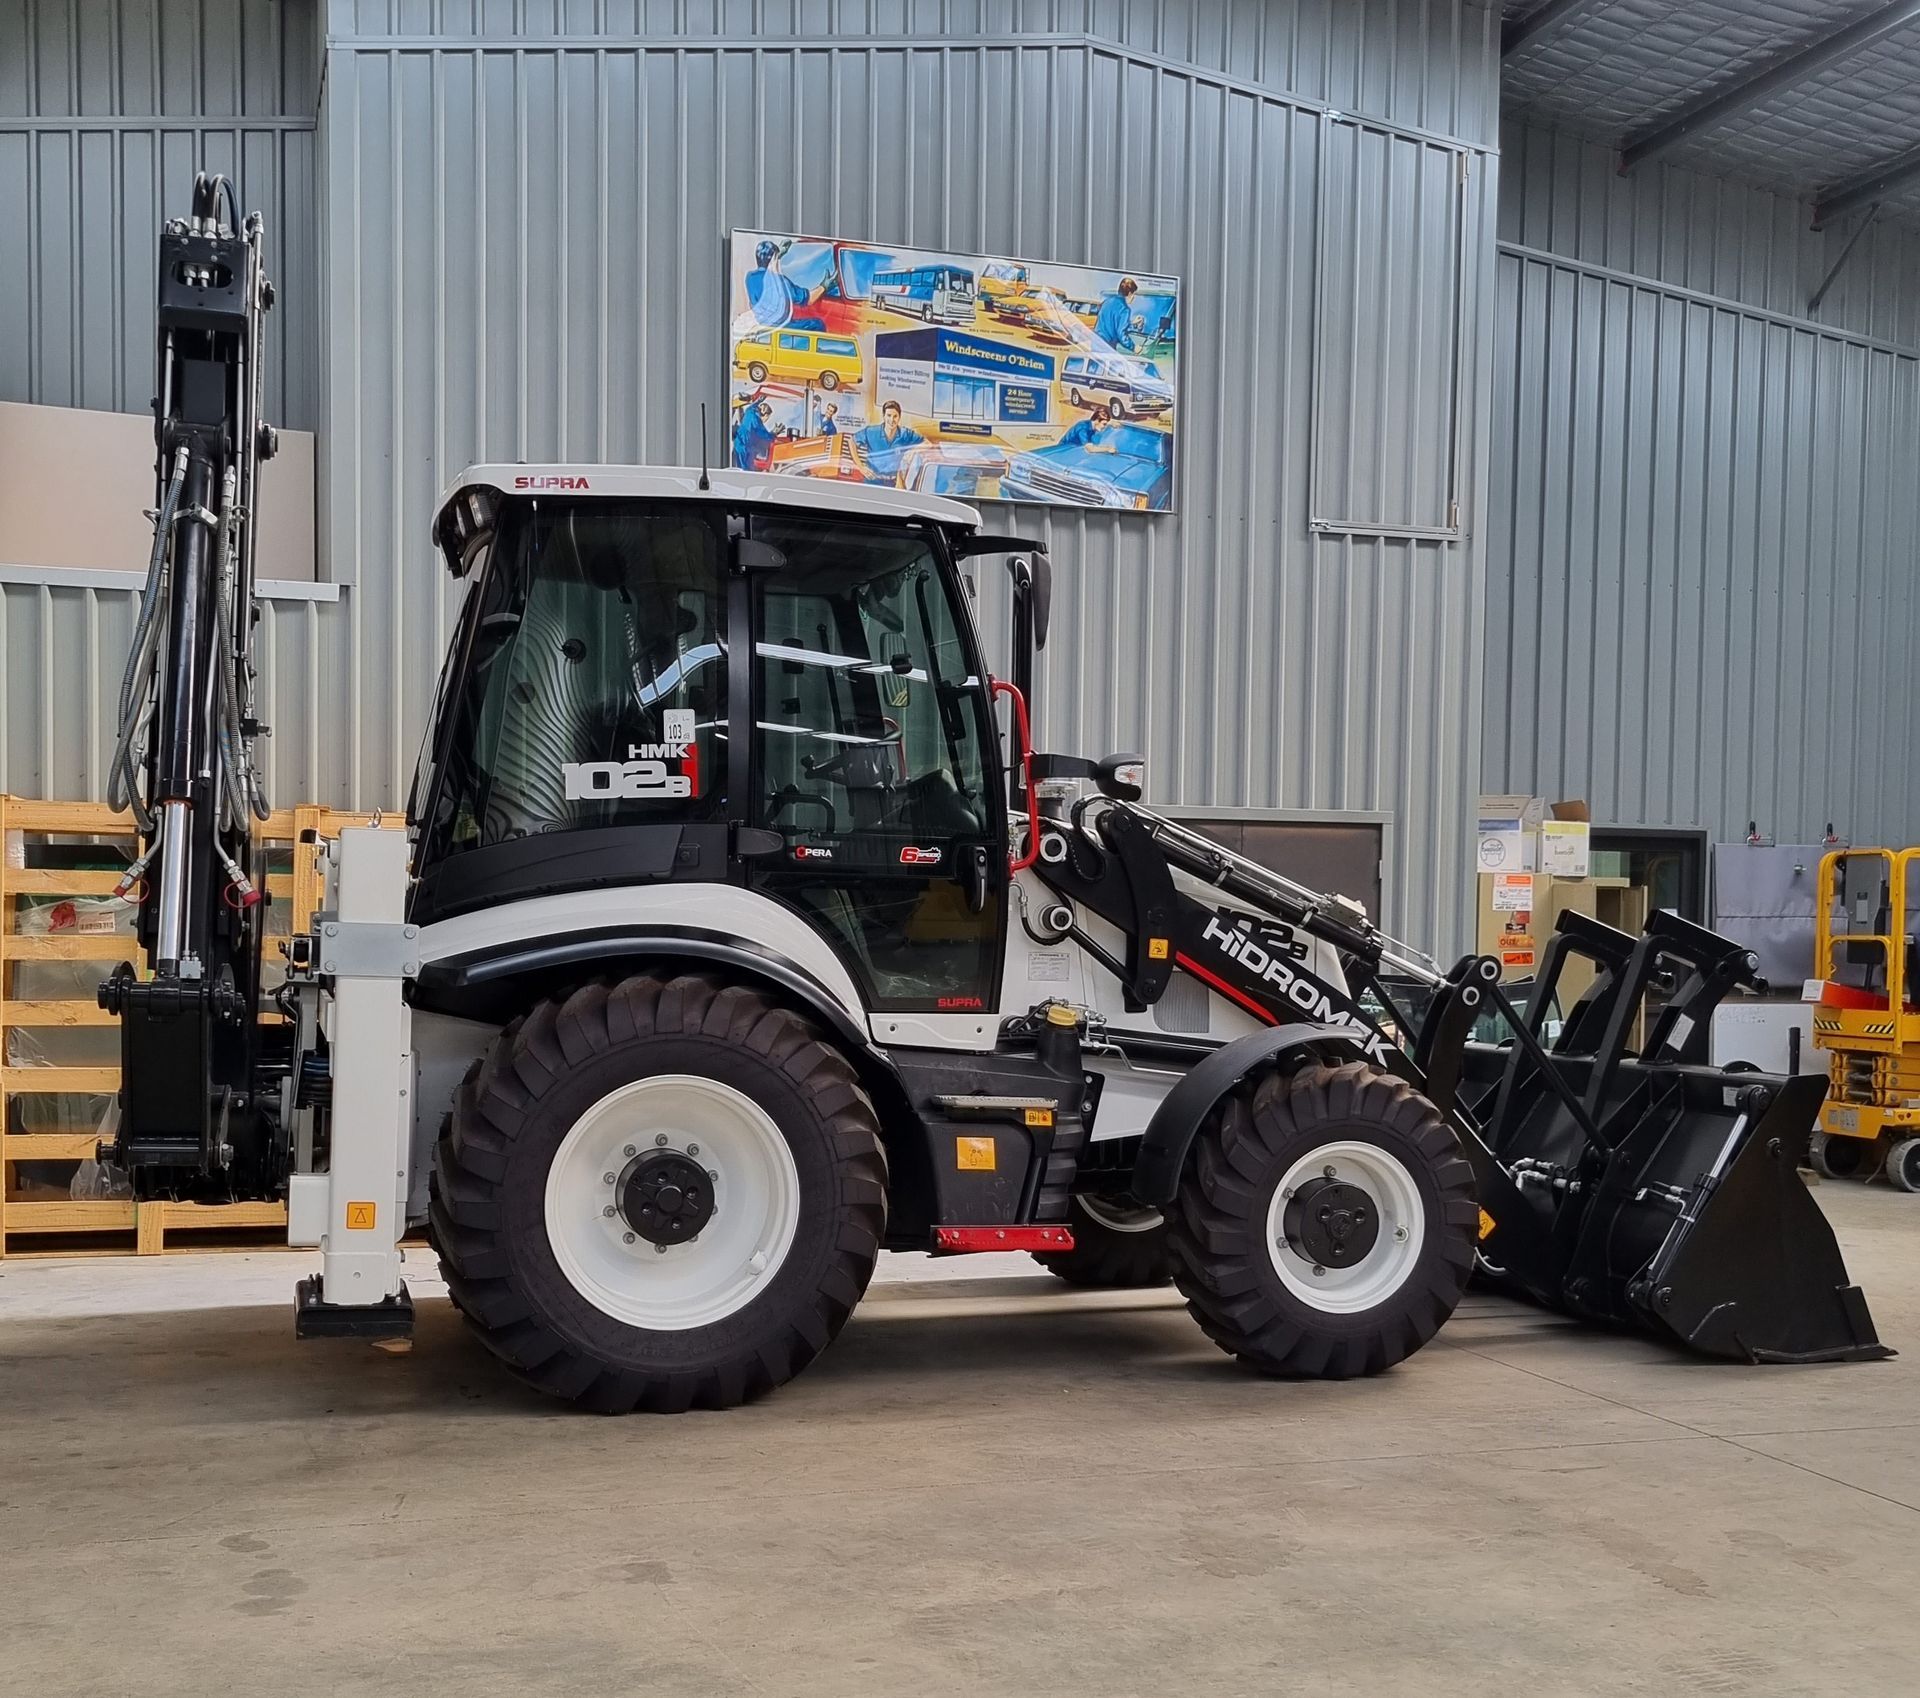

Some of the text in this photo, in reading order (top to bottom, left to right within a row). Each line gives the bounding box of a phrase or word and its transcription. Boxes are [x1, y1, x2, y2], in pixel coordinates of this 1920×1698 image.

[944, 340, 1045, 371] Windscreens O'Brien
[514, 477, 590, 489] SUPRA
[669, 724, 682, 739] 103
[628, 744, 690, 759] HMK
[561, 760, 692, 800] 102B
[796, 846, 833, 859] OPERA
[937, 997, 983, 1008] SUPRA
